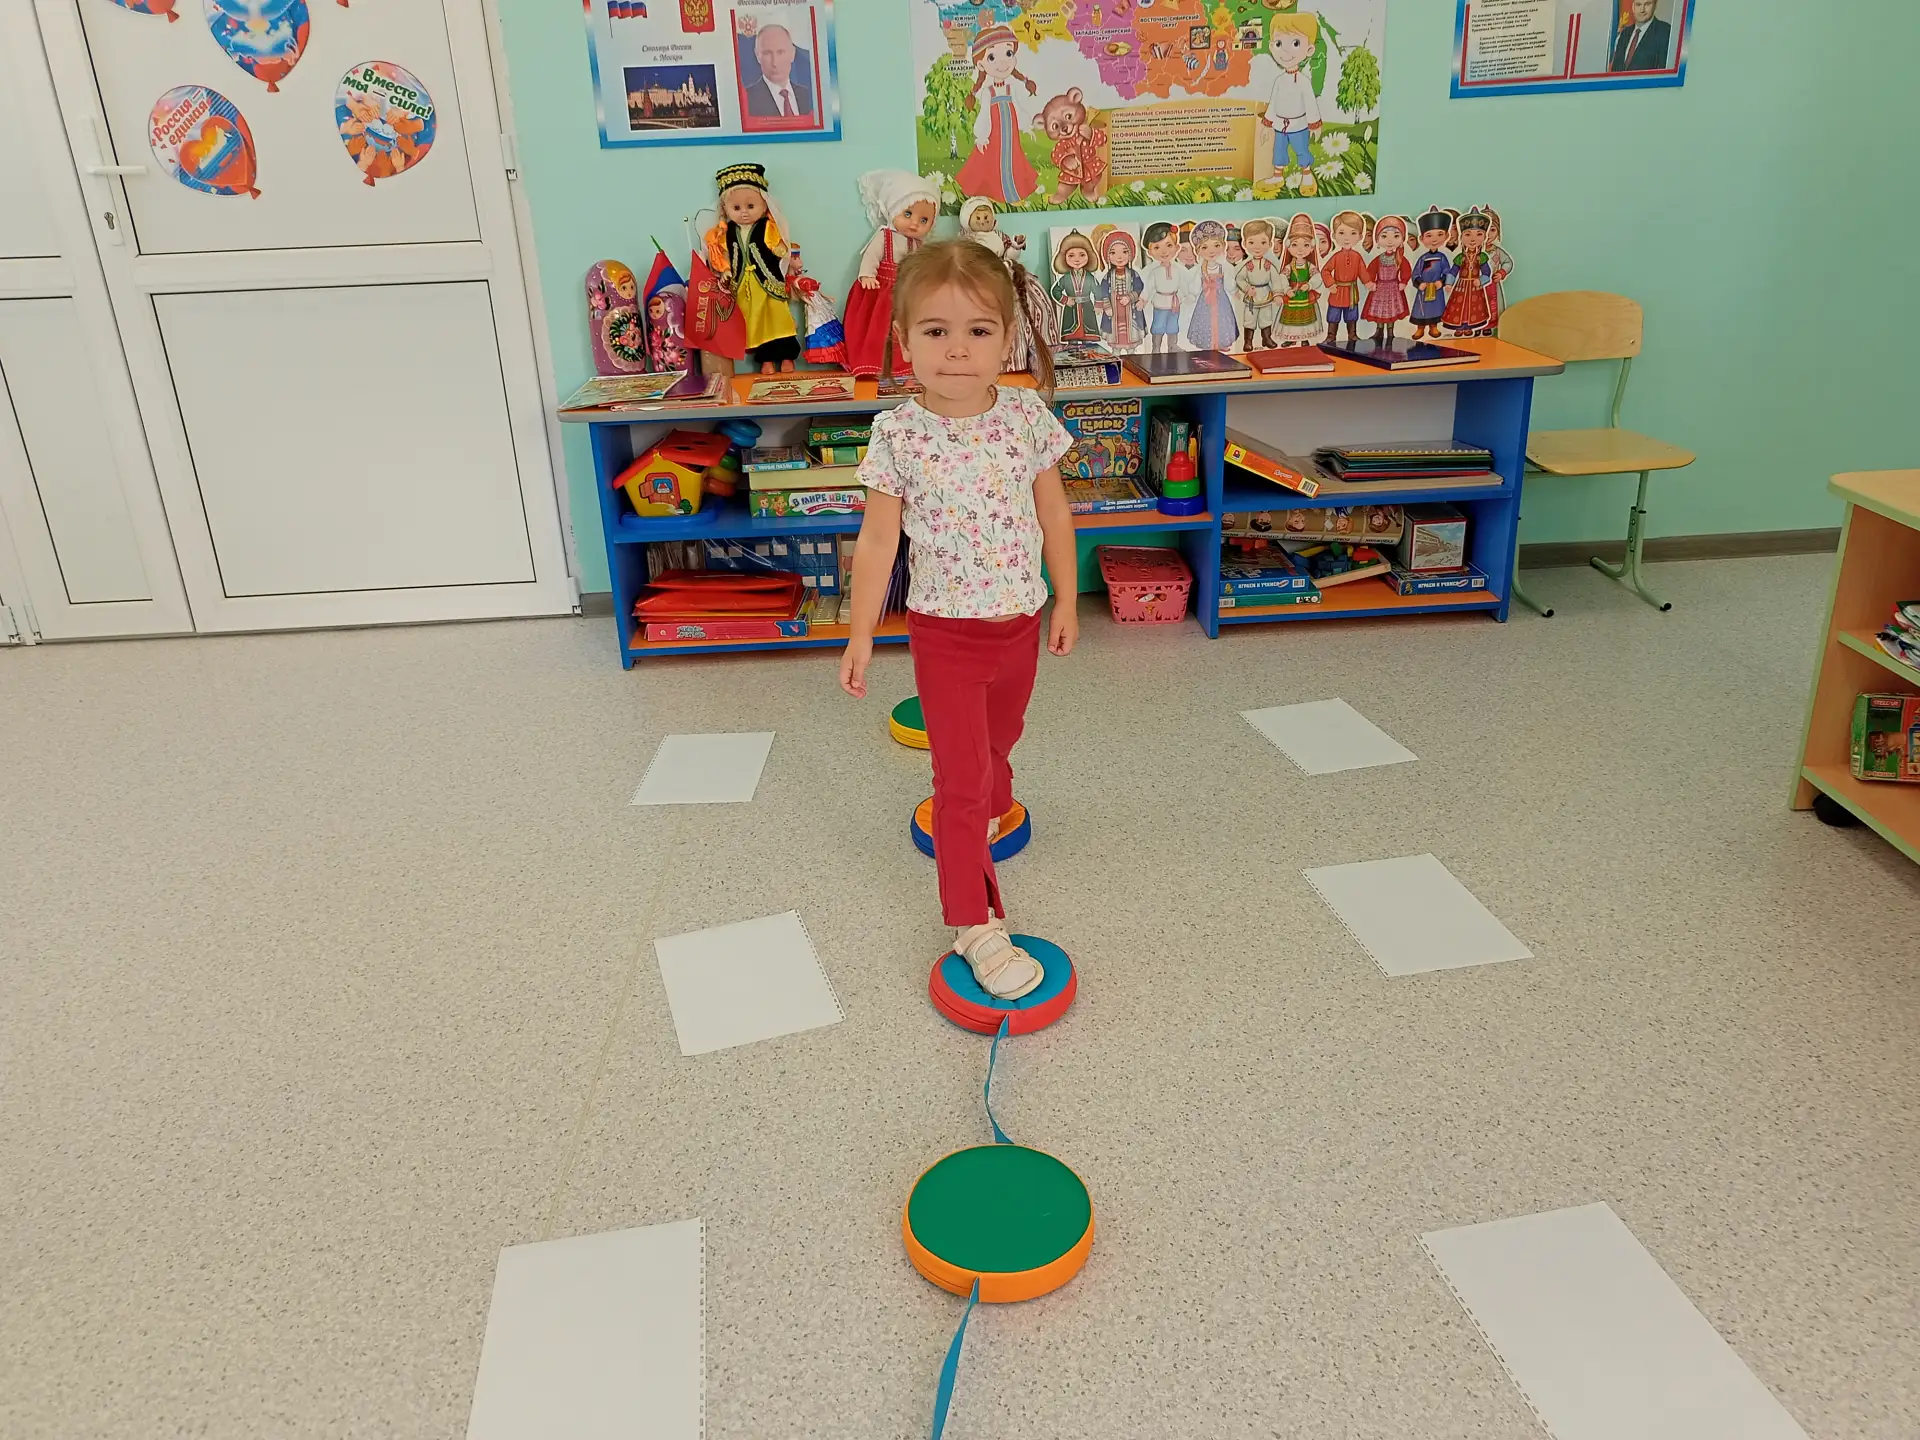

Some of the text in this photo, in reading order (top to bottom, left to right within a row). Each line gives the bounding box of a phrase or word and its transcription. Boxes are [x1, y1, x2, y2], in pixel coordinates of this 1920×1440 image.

[362, 67, 418, 100] Вместе
[342, 75, 433, 120] мы сила!
[152, 98, 194, 142] Россия
[168, 100, 210, 147] единая
[1111, 130, 1170, 138] НЕОФИЦИАЛЬНЫЕ
[1064, 399, 1140, 417] ВЕСЁЛЫЙ
[1080, 418, 1126, 432] ЦИРК
[792, 493, 859, 506] В МИРЕ ЦВЕТА
